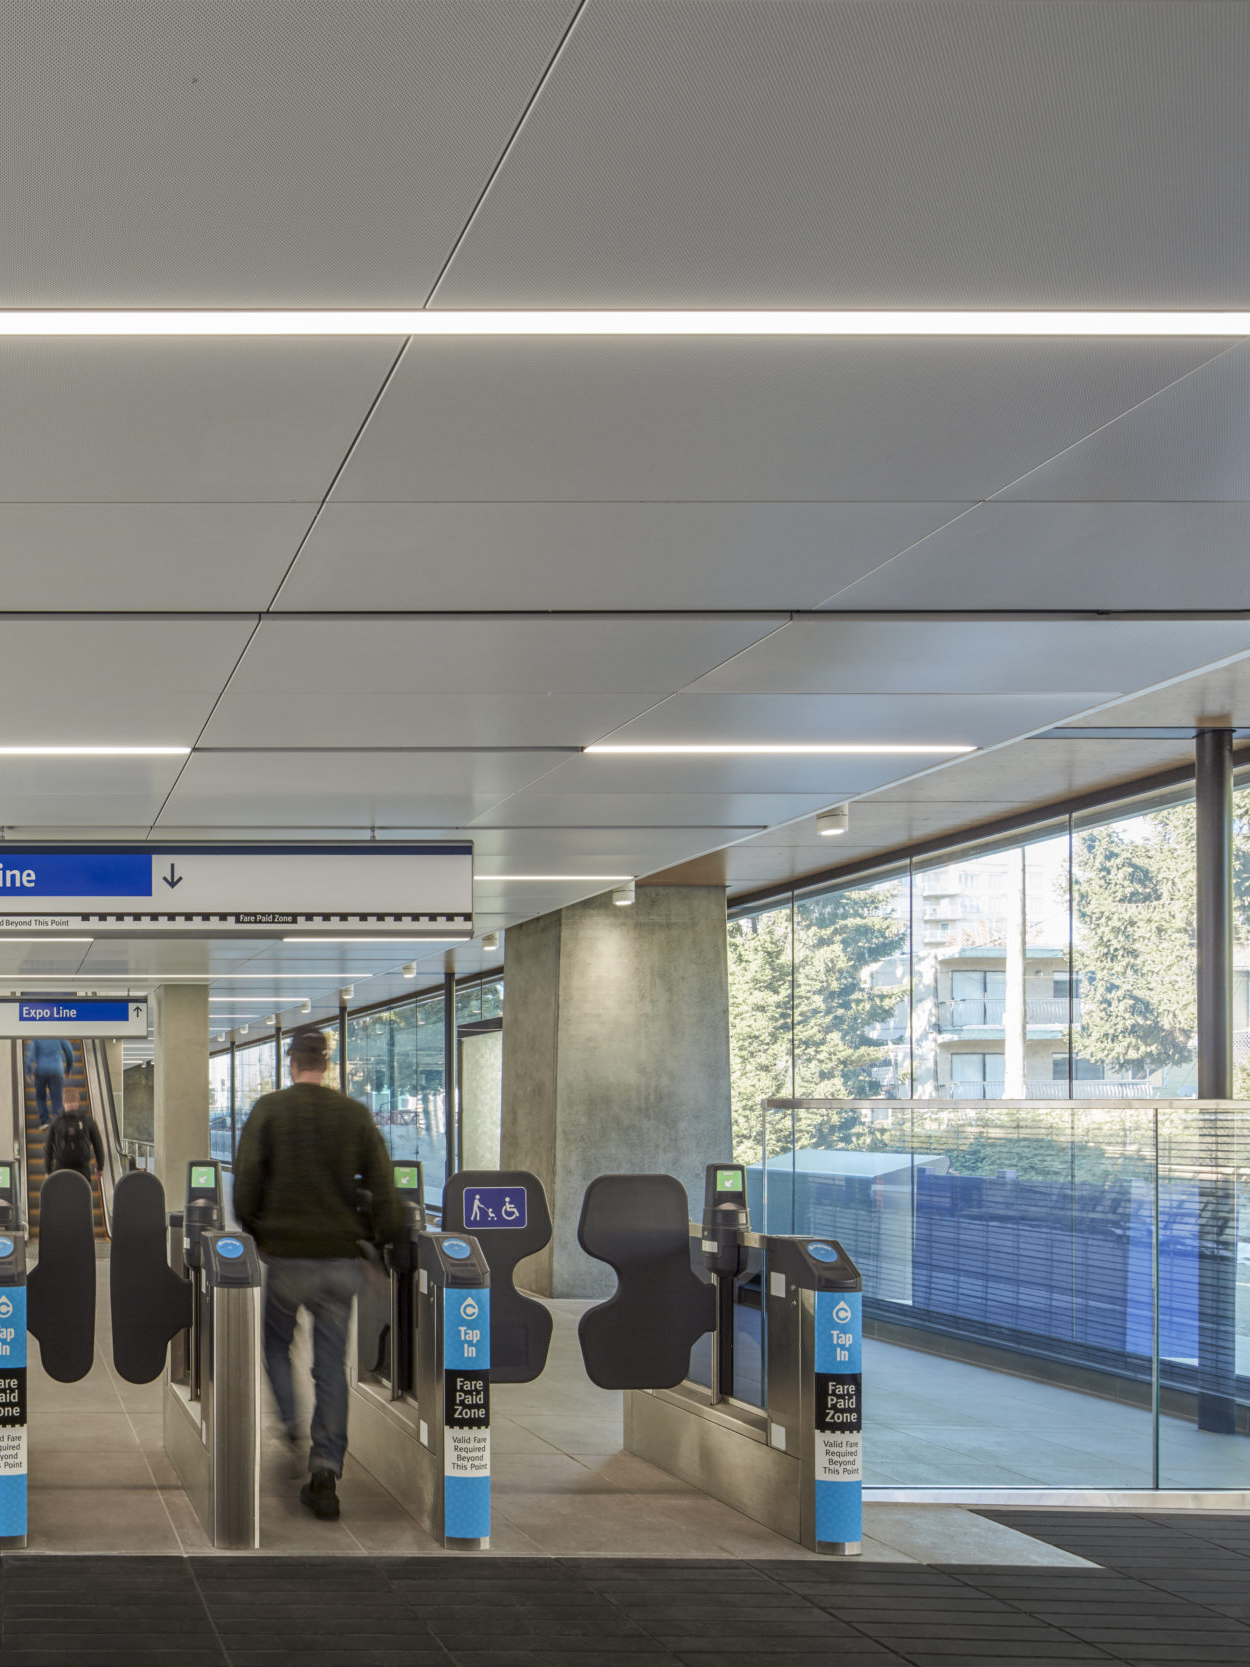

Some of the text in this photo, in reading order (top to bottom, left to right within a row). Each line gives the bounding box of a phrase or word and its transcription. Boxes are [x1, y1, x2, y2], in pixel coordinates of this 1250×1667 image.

[240, 914, 293, 922] Fare Paid Zone
[5, 919, 32, 928] Beyond
[33, 919, 49, 927] This
[50, 919, 70, 927] Point
[23, 1006, 77, 1020] Expo Line
[458, 1327, 480, 1343] Tap
[831, 1331, 852, 1347] Tap
[464, 1344, 476, 1357] In
[836, 1348, 848, 1361] In
[456, 1378, 483, 1391] Fare
[828, 1382, 855, 1395] Fare
[456, 1392, 484, 1404] Paid
[828, 1396, 856, 1408] Paid
[454, 1407, 485, 1418] Zone
[825, 1410, 857, 1422] Zone
[452, 1436, 470, 1444] Valid
[823, 1440, 859, 1448] Valid Fare
[453, 1445, 486, 1454] Required
[825, 1448, 858, 1458] Required
[456, 1454, 483, 1463] Beyond
[828, 1457, 856, 1467] Beyond
[3, 1461, 22, 1469] Point
[451, 1463, 468, 1471] This
[823, 1466, 859, 1475] This Point
